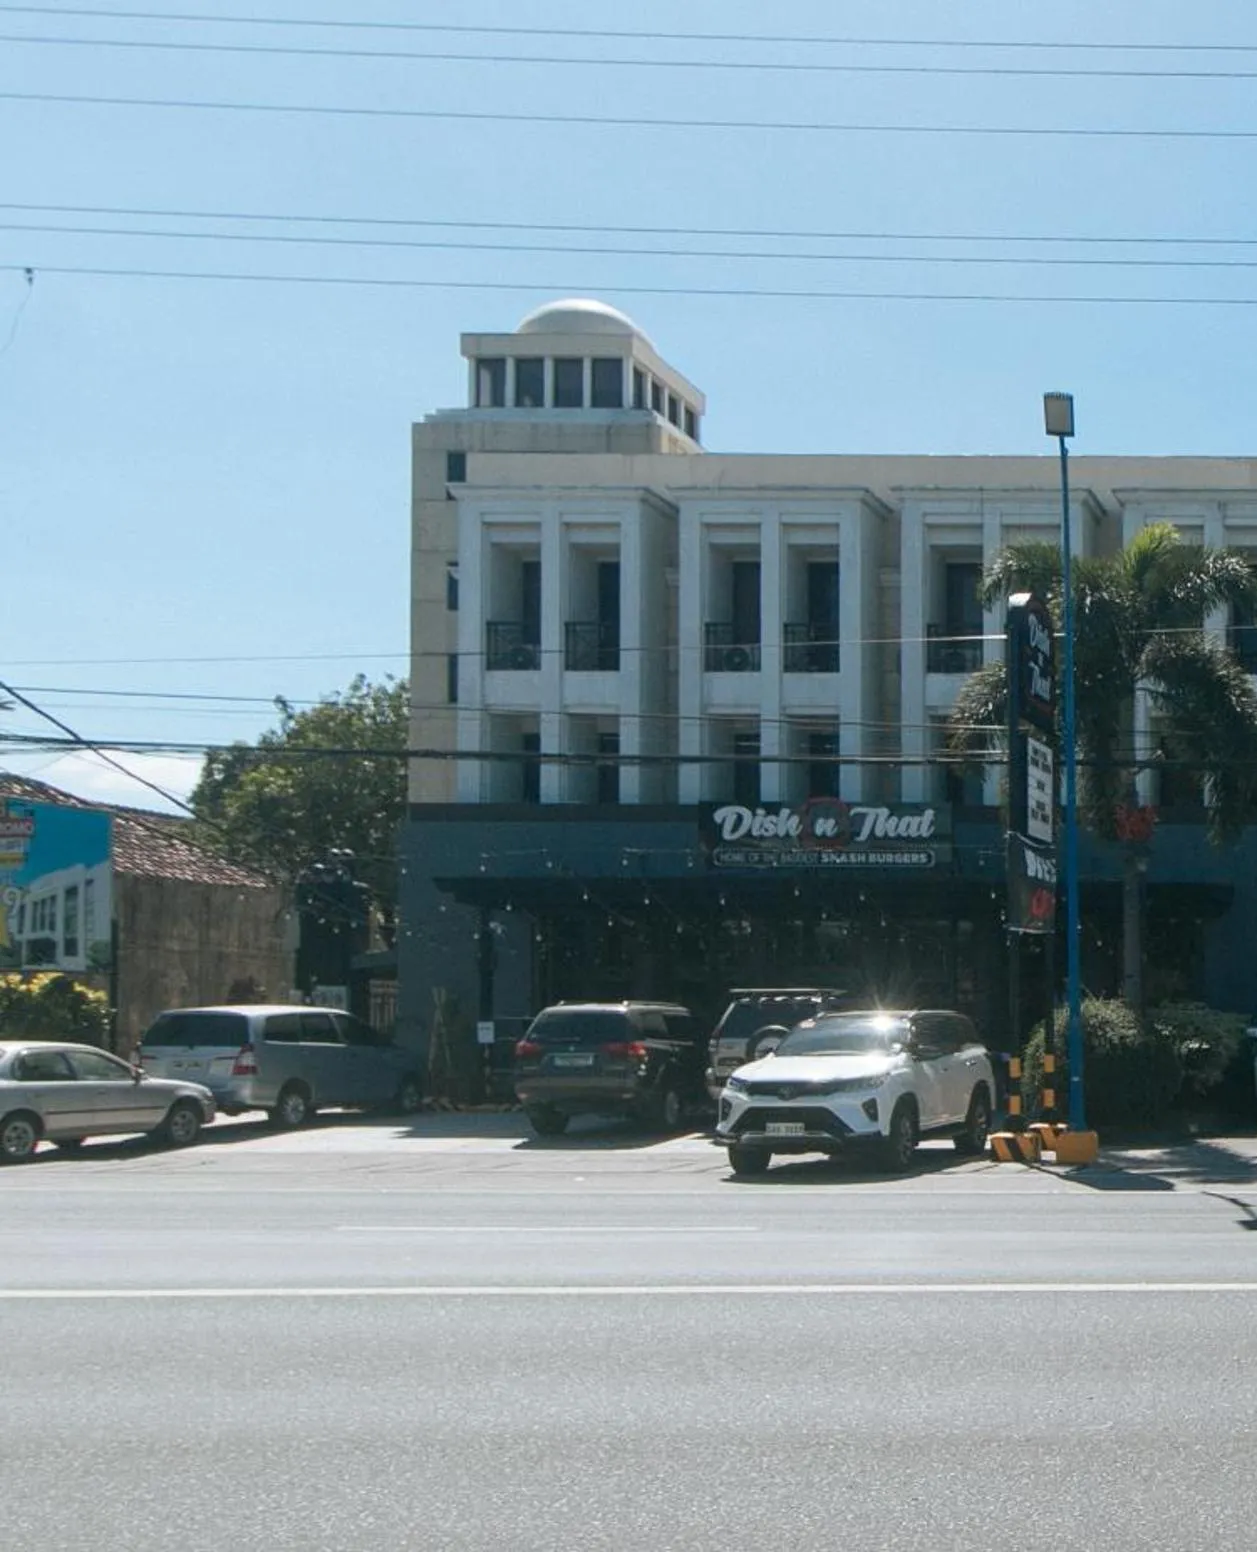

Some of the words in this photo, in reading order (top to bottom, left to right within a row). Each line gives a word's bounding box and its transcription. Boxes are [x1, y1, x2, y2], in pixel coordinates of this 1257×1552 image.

[713, 805, 803, 841] Dish
[814, 816, 837, 837] n
[849, 806, 935, 841] That
[821, 853, 866, 863] SMASH
[868, 853, 928, 863] BURGERS
